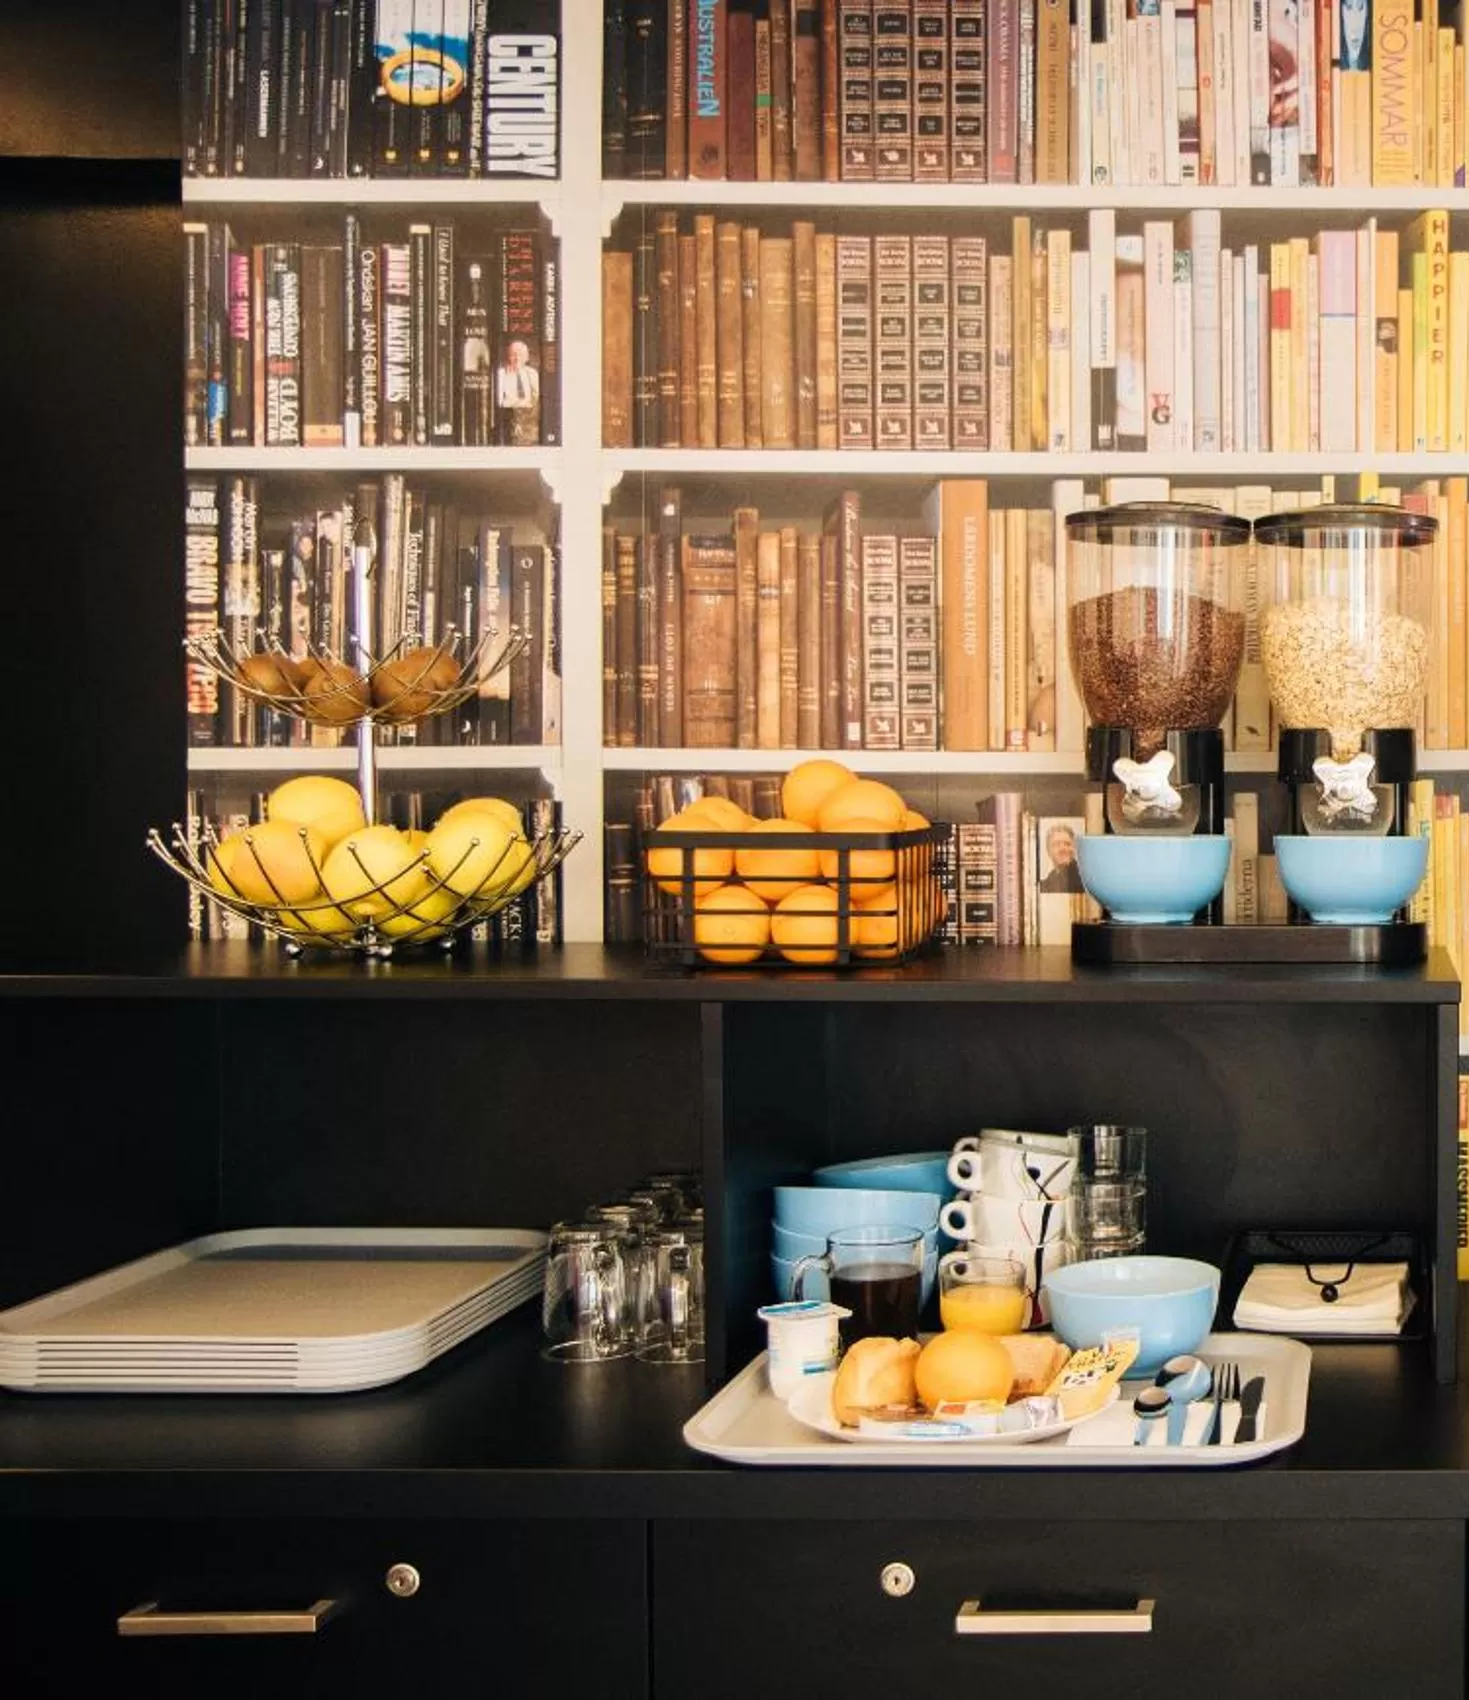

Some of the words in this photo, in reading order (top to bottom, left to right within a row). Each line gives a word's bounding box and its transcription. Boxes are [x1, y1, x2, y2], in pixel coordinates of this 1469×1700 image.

[487, 33, 557, 178] CENTURY
[1379, 14, 1409, 148] SOMMAR
[361, 250, 376, 312] Ondskan
[1431, 219, 1446, 365] HAPPIER
[363, 318, 376, 351] JAN
[280, 377, 299, 442] BOYD
[186, 535, 218, 604] BRAVO
[406, 530, 423, 591] Techniques
[407, 593, 422, 607] of
